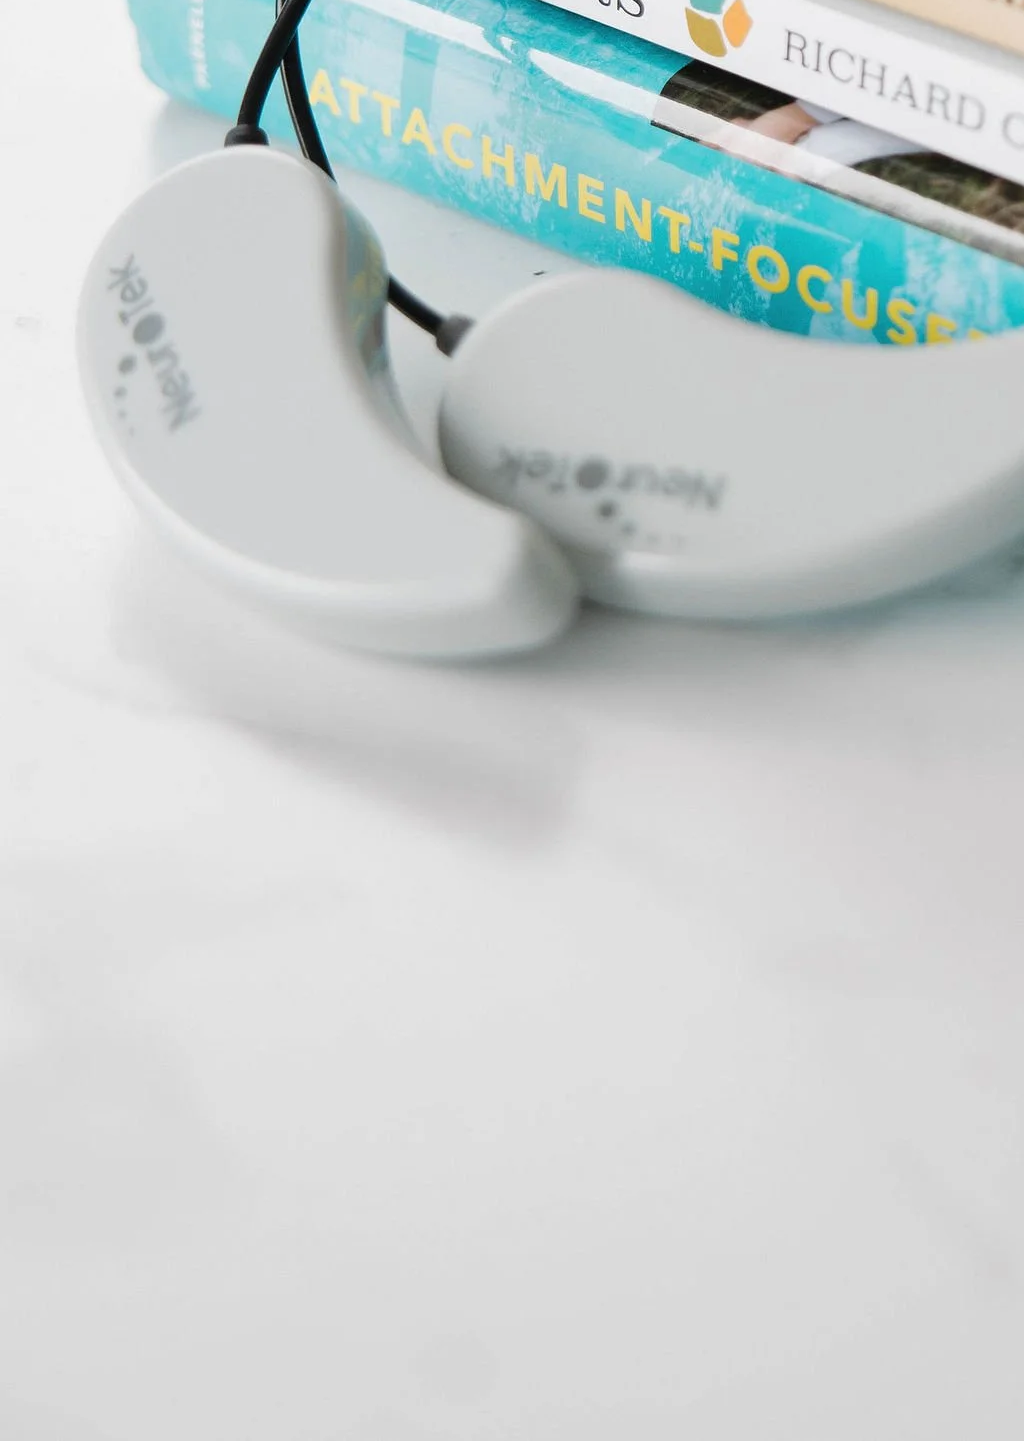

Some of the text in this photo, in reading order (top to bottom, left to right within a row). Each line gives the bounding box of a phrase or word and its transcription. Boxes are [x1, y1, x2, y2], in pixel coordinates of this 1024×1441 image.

[782, 28, 988, 133] RICHARD
[309, 68, 988, 348] ATTACHMENT-FOCUSE
[104, 250, 205, 434] NeuroTek
[492, 443, 730, 513] NeuroTek
